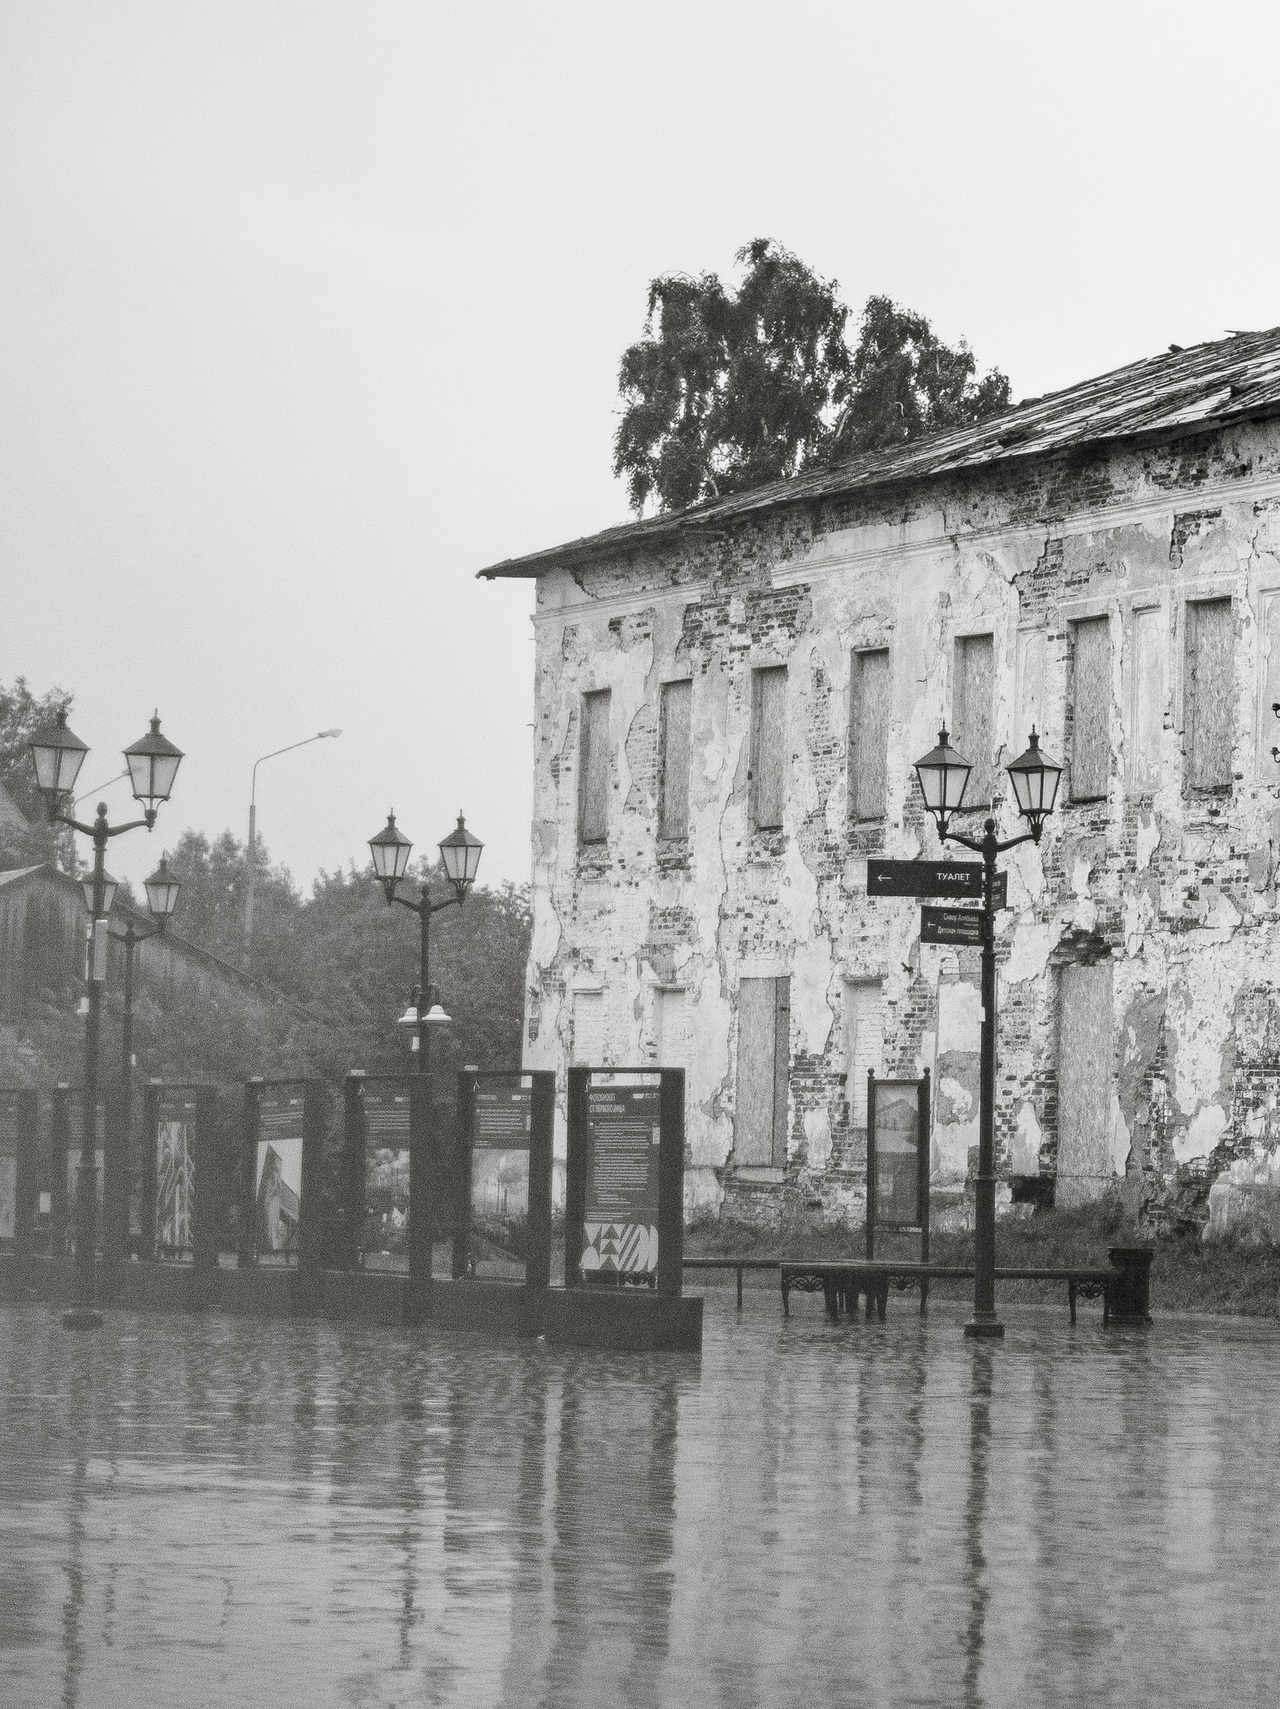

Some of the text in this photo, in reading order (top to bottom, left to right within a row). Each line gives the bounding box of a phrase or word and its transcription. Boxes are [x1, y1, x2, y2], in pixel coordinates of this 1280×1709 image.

[936, 872, 971, 881] ТУАЛЕТ
[937, 925, 979, 936] Детская площадка
